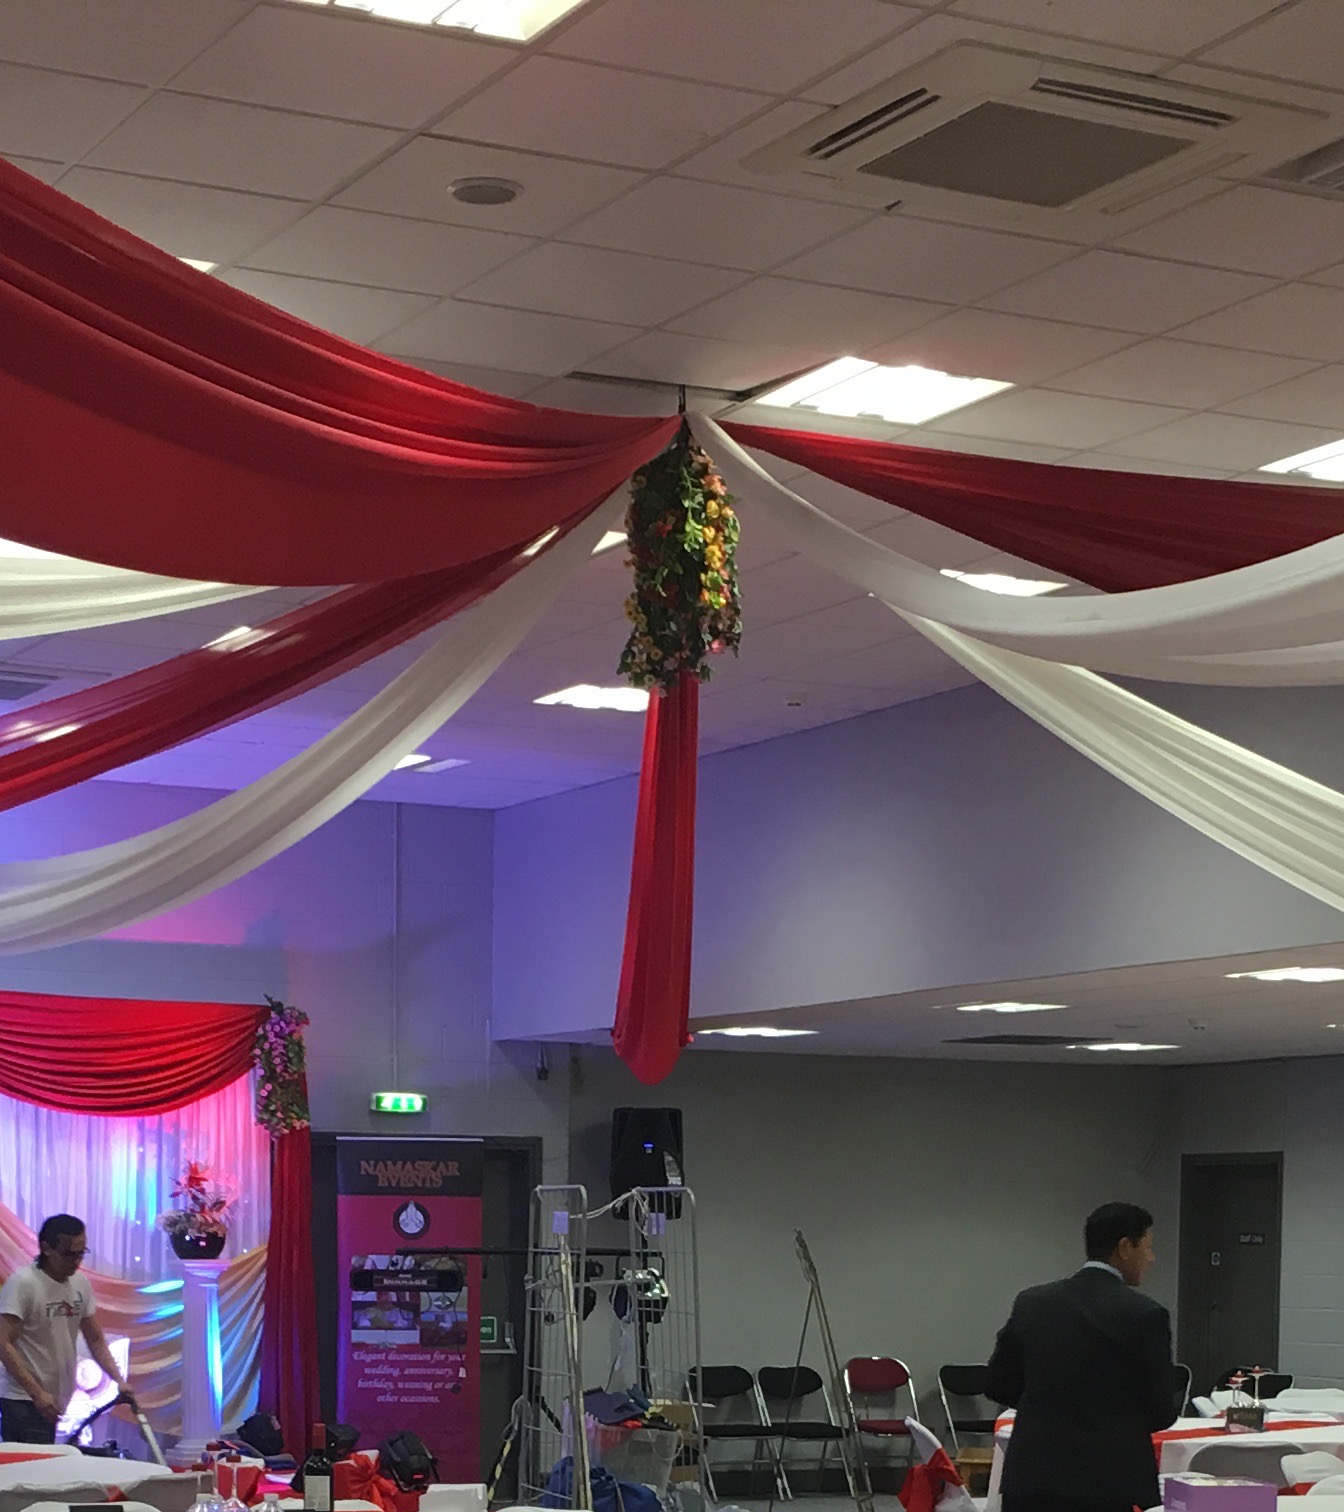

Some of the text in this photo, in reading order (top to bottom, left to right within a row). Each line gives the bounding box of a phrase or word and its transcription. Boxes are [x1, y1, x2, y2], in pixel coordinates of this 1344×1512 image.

[360, 1160, 460, 1176] NAMASKAR
[377, 1173, 443, 1188] EVENTS
[352, 1350, 386, 1362] Elegant
[388, 1350, 431, 1361] decoration
[430, 1351, 446, 1363] for
[434, 1381, 443, 1389] or
